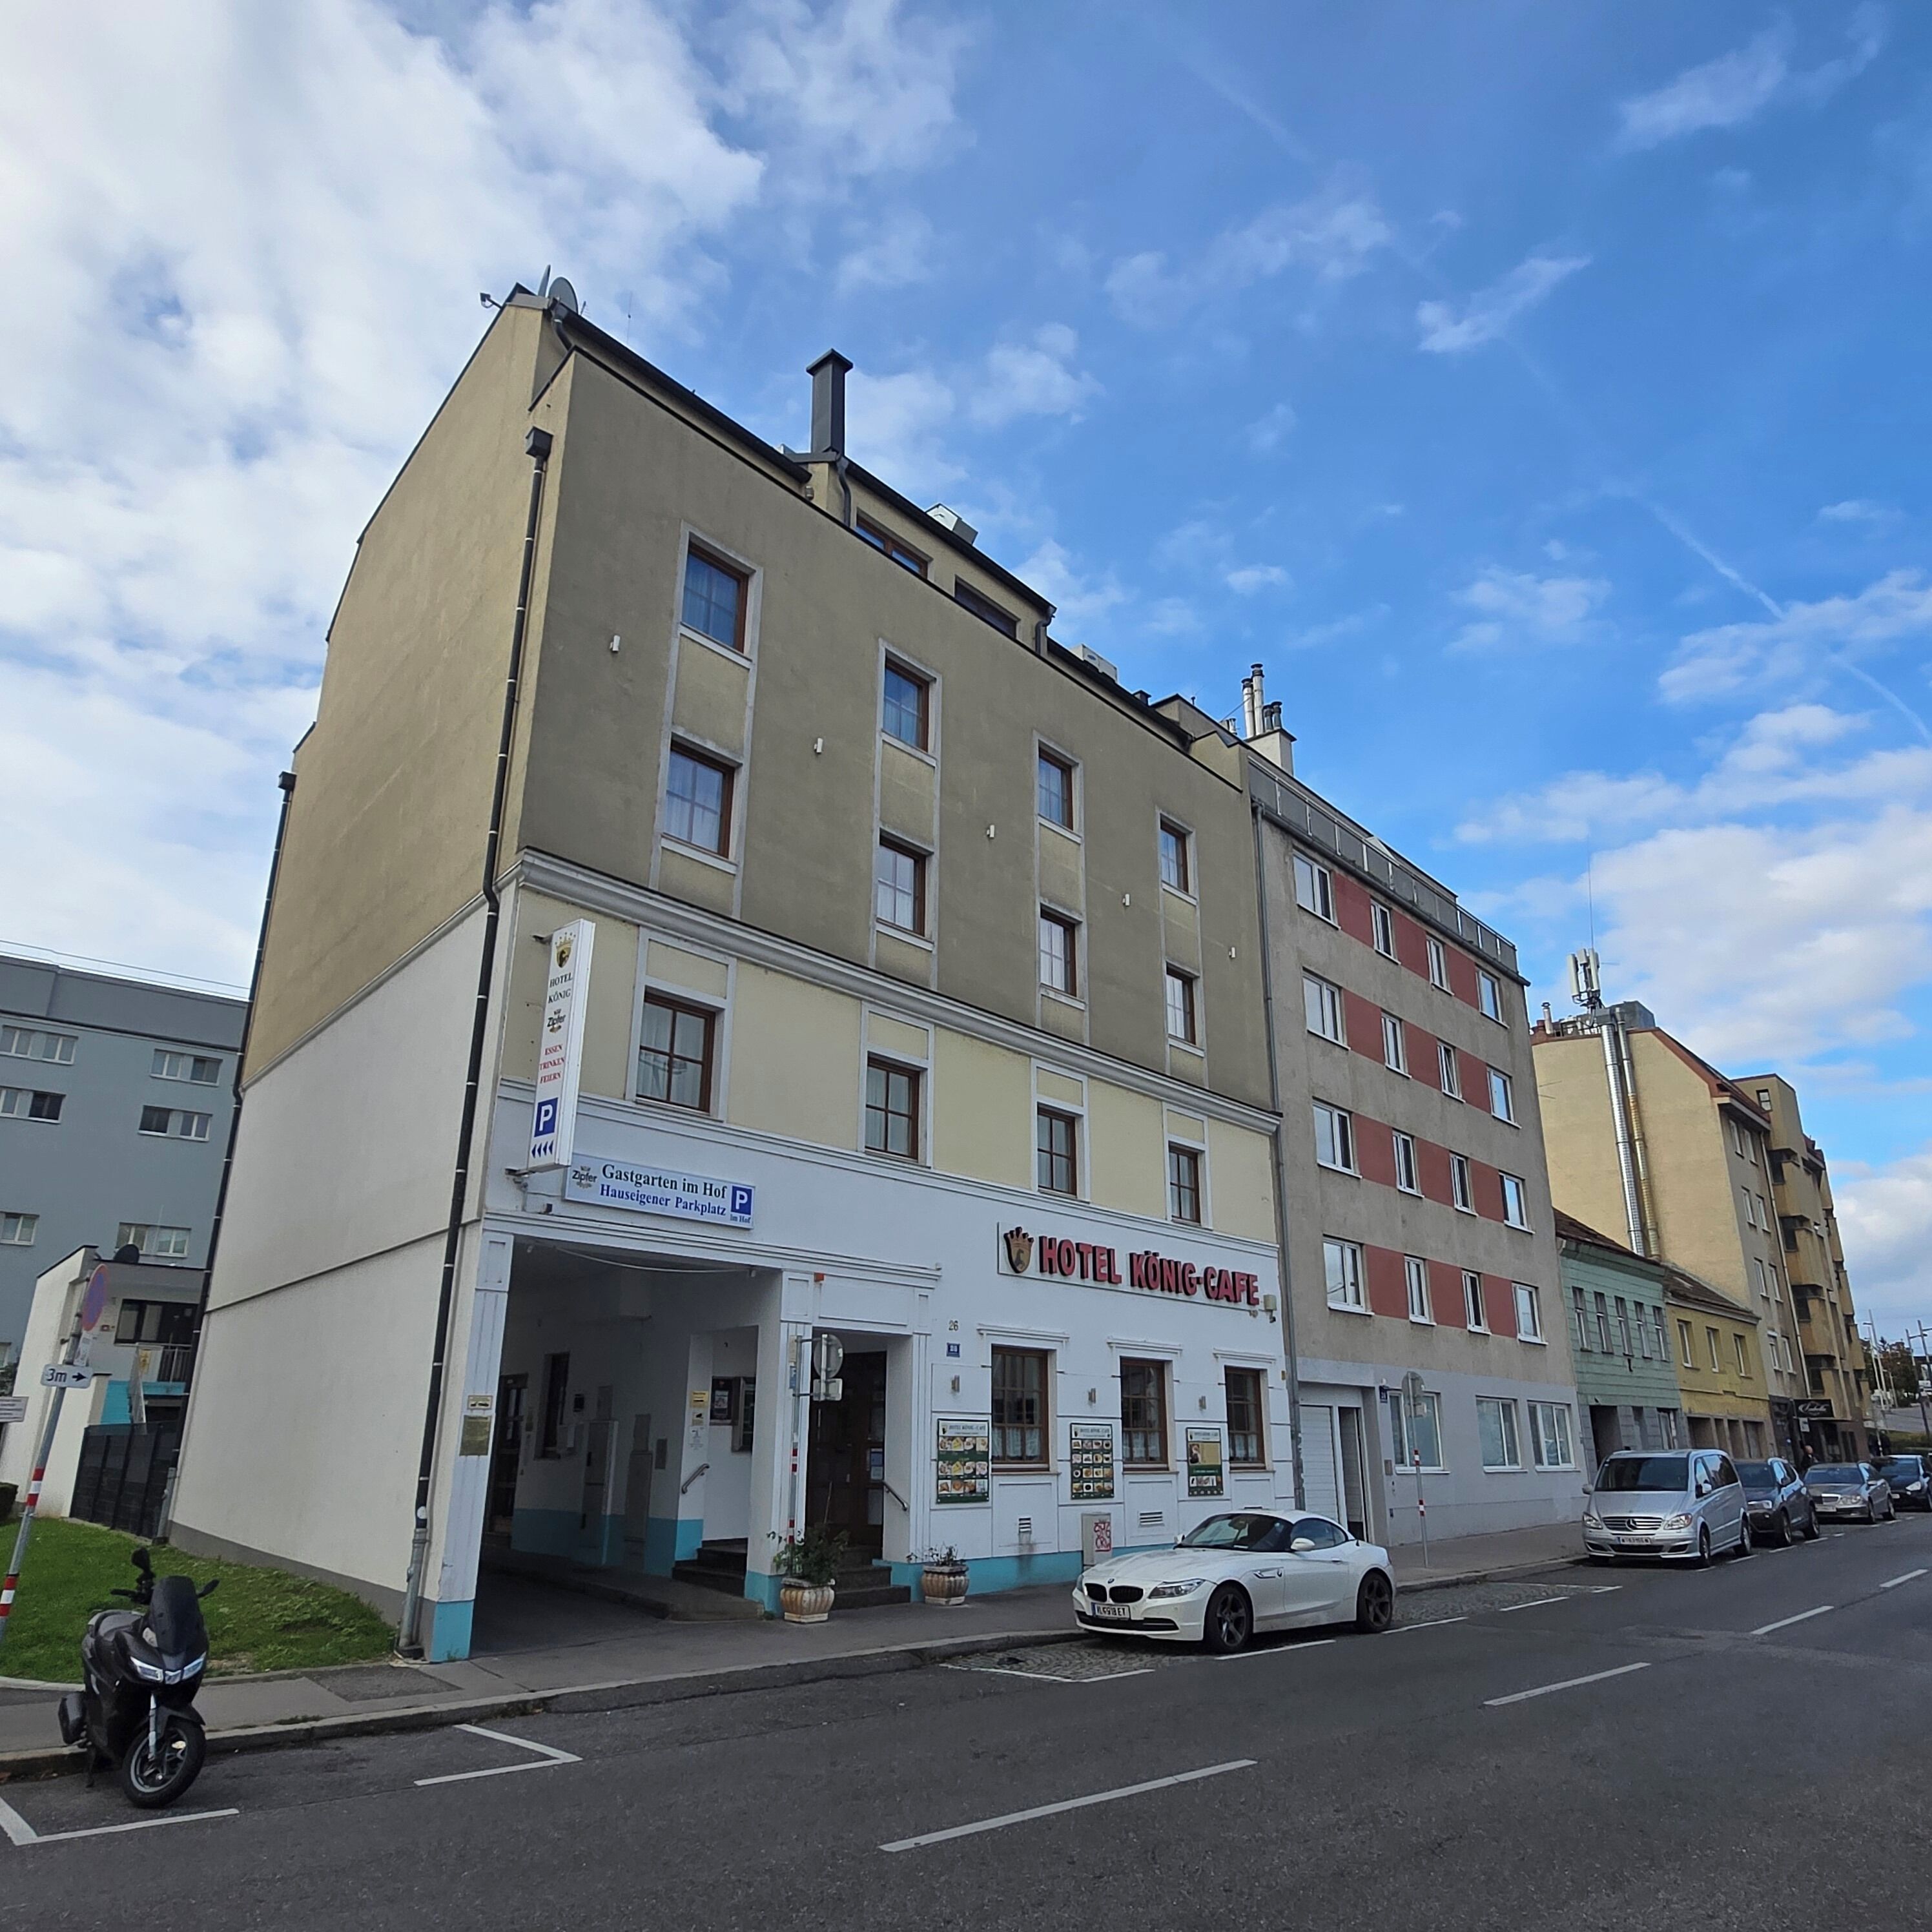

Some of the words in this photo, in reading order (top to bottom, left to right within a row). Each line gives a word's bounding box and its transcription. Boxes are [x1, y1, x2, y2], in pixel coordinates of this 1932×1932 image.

[550, 972, 573, 988] HOTEL
[548, 989, 571, 1003] KÖNIG
[547, 1014, 566, 1027] Zipfer
[544, 1044, 562, 1056] ESSEN
[540, 1056, 566, 1071] TRINKEN
[540, 1071, 562, 1084] FEIERN
[539, 1104, 553, 1131] P
[572, 1170, 597, 1183] Zipfer
[602, 1164, 677, 1190] Gastgarten
[683, 1178, 698, 1194] im
[703, 1182, 727, 1199] Hof
[600, 1183, 671, 1207] Hauseigener
[675, 1196, 726, 1216] Parkplatz
[735, 1190, 748, 1210] P
[1039, 1235, 1122, 1284] HOTEL
[949, 1320, 958, 1331] 26
[46, 1368, 67, 1383] 3m
